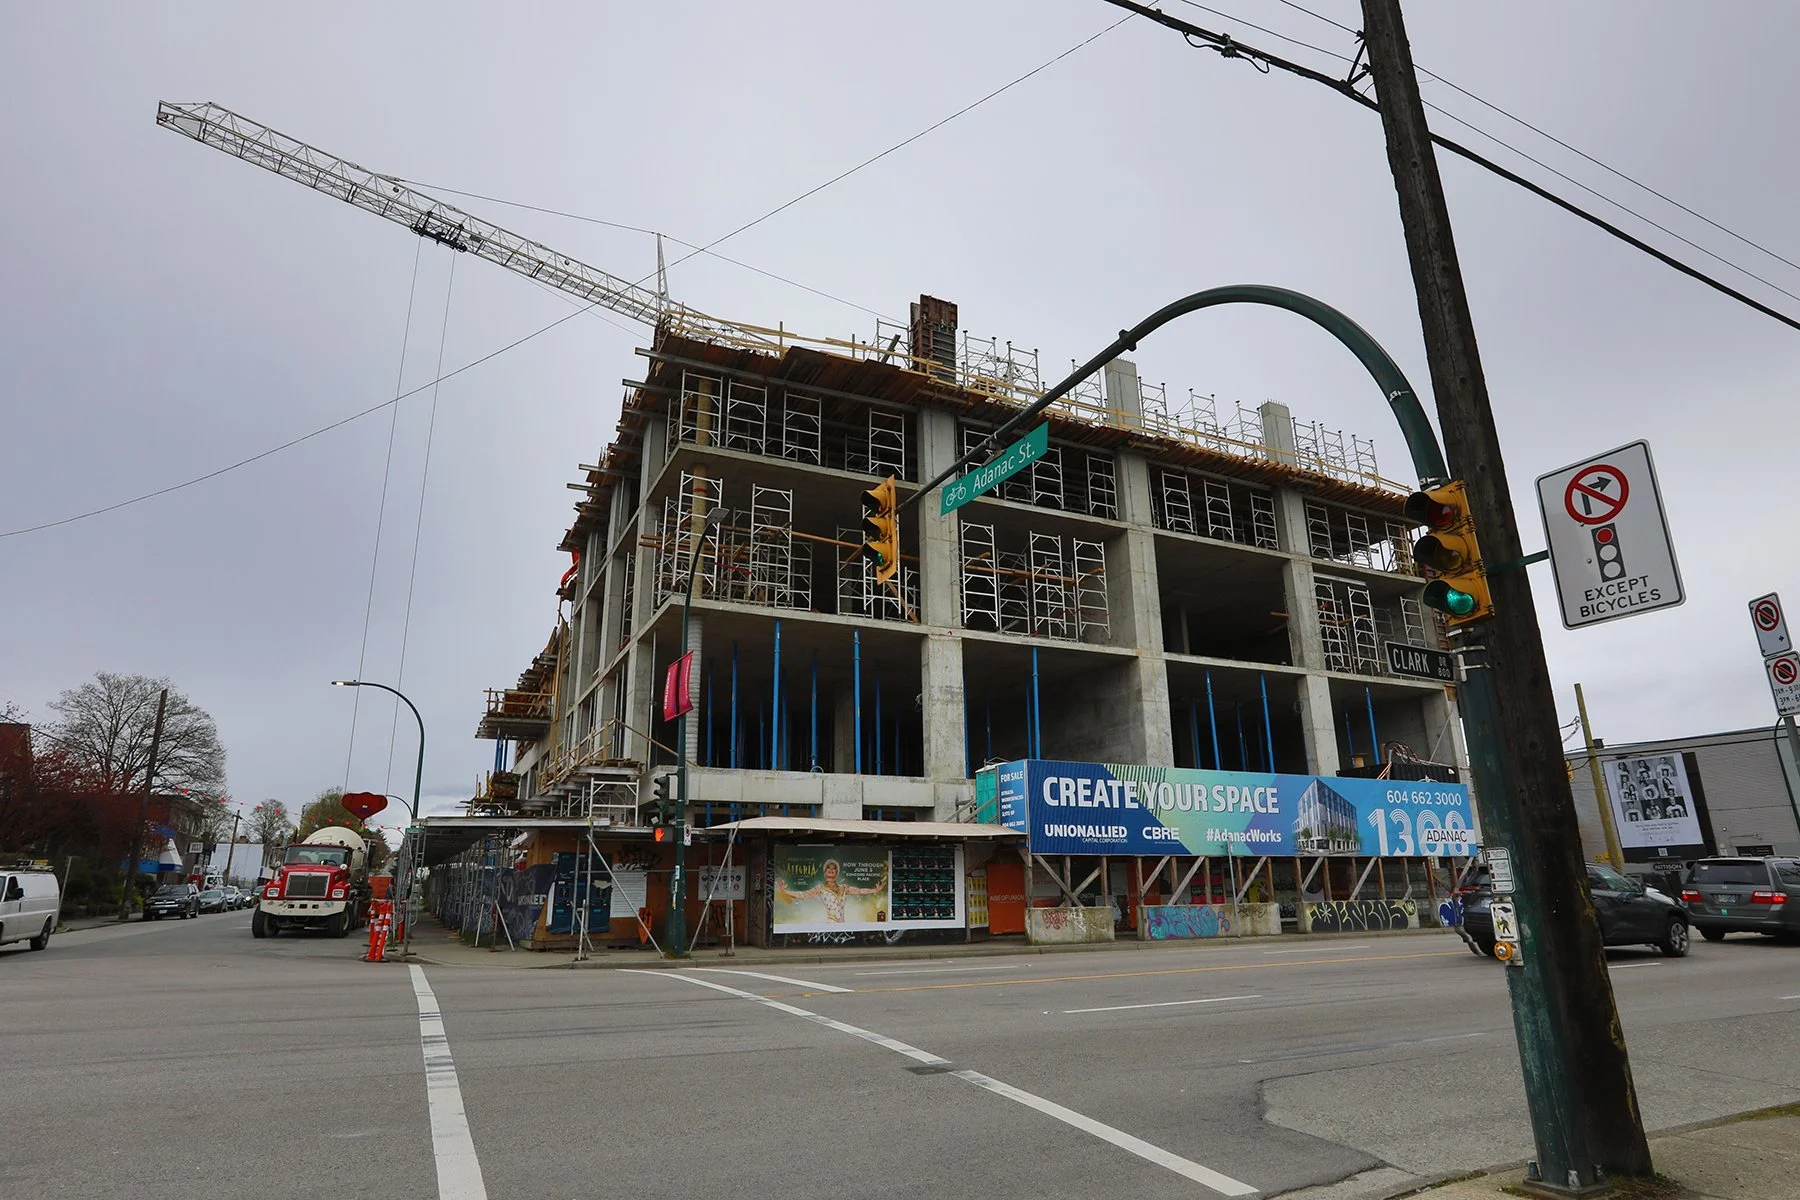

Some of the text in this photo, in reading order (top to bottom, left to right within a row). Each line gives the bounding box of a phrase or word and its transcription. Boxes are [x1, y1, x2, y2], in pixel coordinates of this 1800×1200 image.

[973, 442, 1035, 492] Adanac St.
[1584, 575, 1649, 602] EXCEPT
[1580, 588, 1662, 617] BICYCLES
[1393, 648, 1430, 673] CLARK
[1438, 656, 1447, 667] DR
[1438, 667, 1451, 678] 800
[1001, 770, 1023, 783] FOR SALE
[1043, 776, 1280, 814] CREATE YOUR SPACE
[1387, 790, 1462, 806] 604 662 3000
[1044, 824, 1128, 838] UNIONALLIED
[1142, 826, 1180, 840] CBRE
[1206, 828, 1281, 843] #AdanacWorks
[1427, 830, 1468, 843] ADANAC
